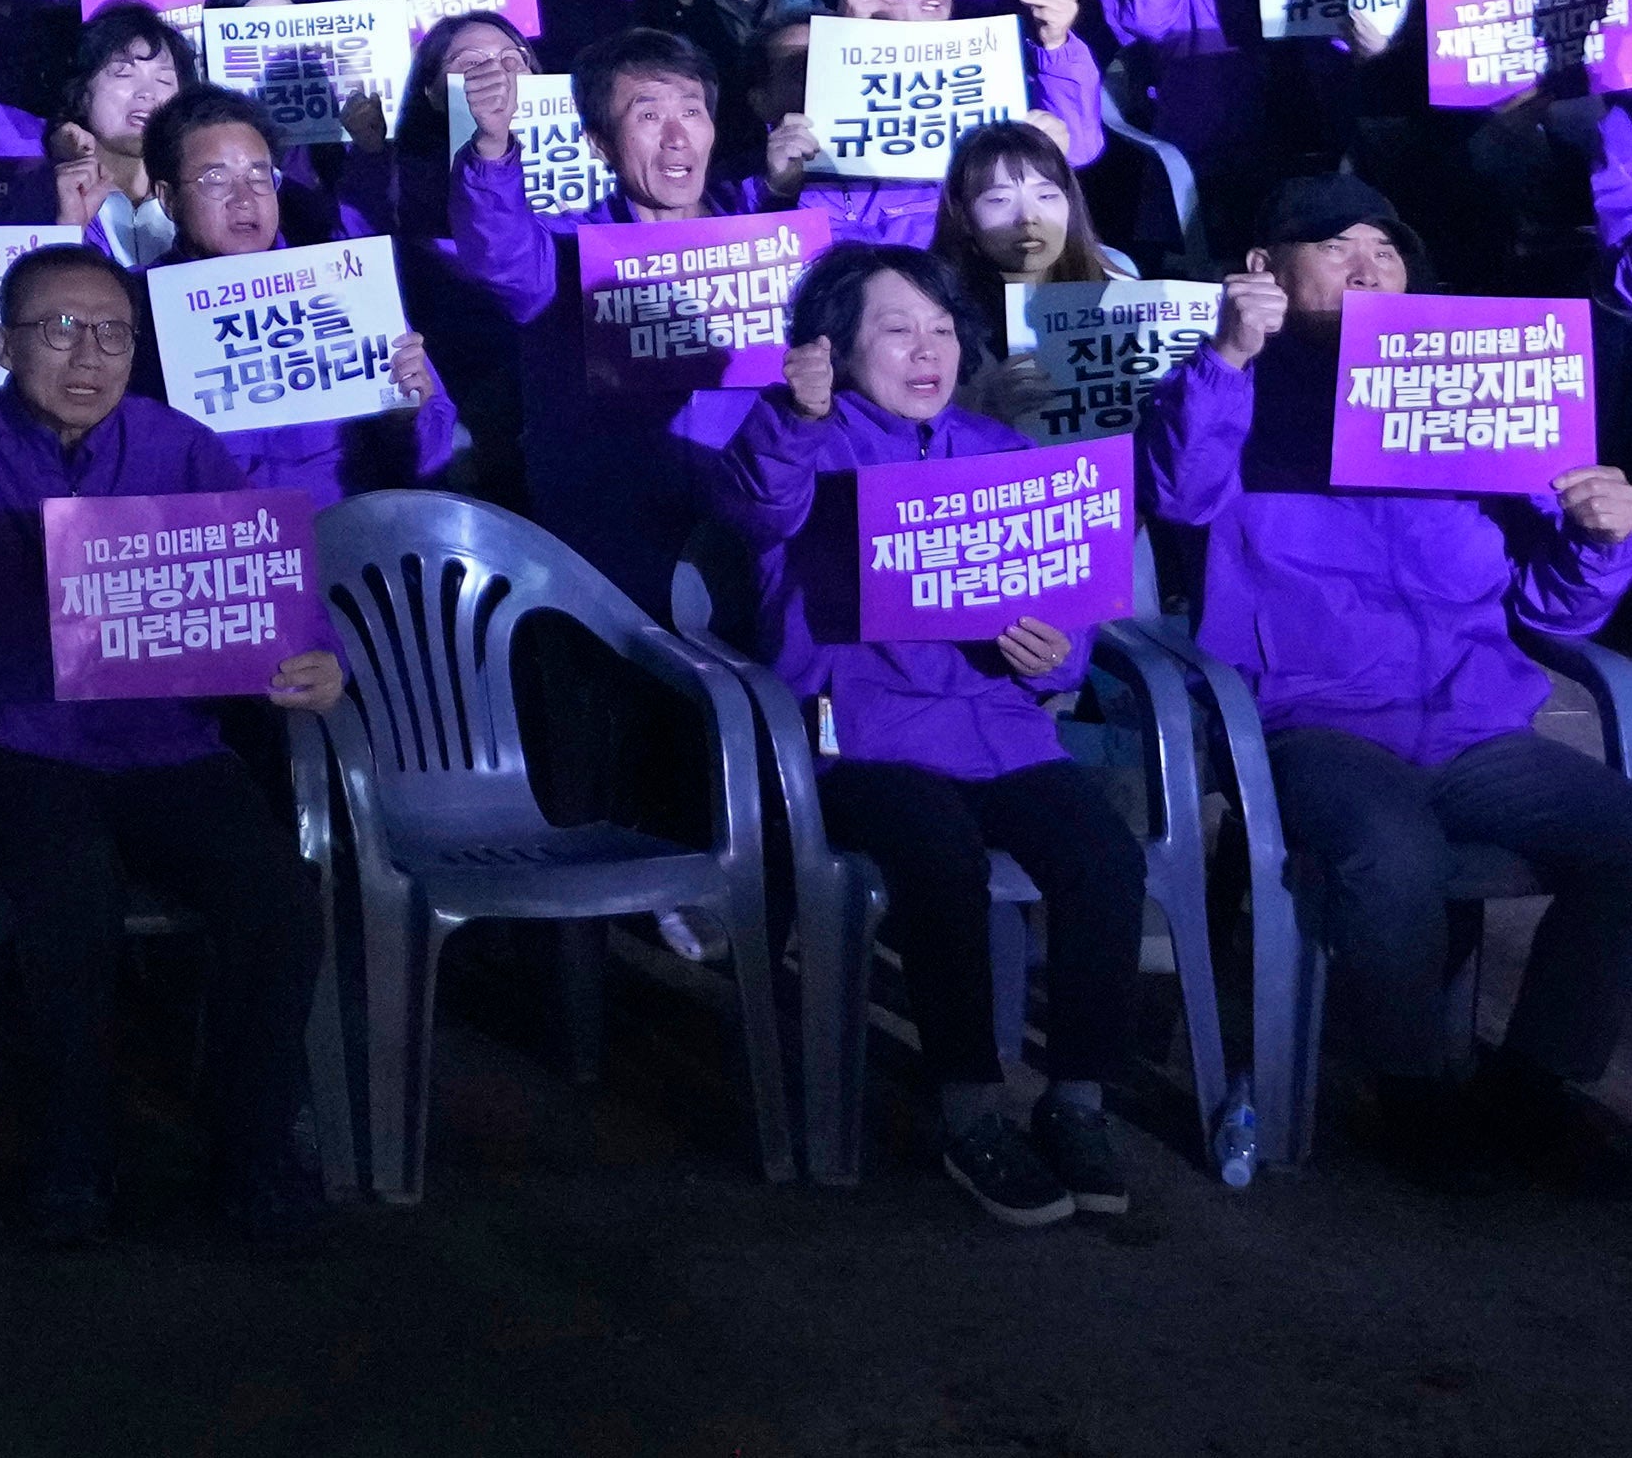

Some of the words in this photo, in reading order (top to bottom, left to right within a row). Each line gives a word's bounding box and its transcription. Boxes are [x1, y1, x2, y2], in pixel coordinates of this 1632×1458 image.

[218, 18, 270, 40] 10.29
[839, 45, 898, 67] 10.29
[905, 36, 964, 62] 이태원
[861, 64, 986, 112] 진상을
[613, 252, 676, 279] 10.29
[682, 241, 746, 270] 이태원
[184, 282, 244, 312] 10.29
[250, 269, 316, 303] 이태원
[211, 290, 351, 357] 진상을
[1377, 333, 1445, 356] 10.29
[1450, 330, 1515, 355] 이태원
[1348, 355, 1584, 411] 재발방지대책
[1381, 404, 1560, 450] 마련하라!
[896, 496, 966, 523] 10.29
[972, 478, 1045, 514] 이태원
[83, 536, 151, 566] 10.29
[156, 527, 225, 558] 이태원
[871, 488, 1120, 572] 재발방지대책
[59, 548, 304, 621] 재발방지대책
[911, 554, 1090, 611] 마련하라!
[102, 607, 277, 662] 마련하라!
